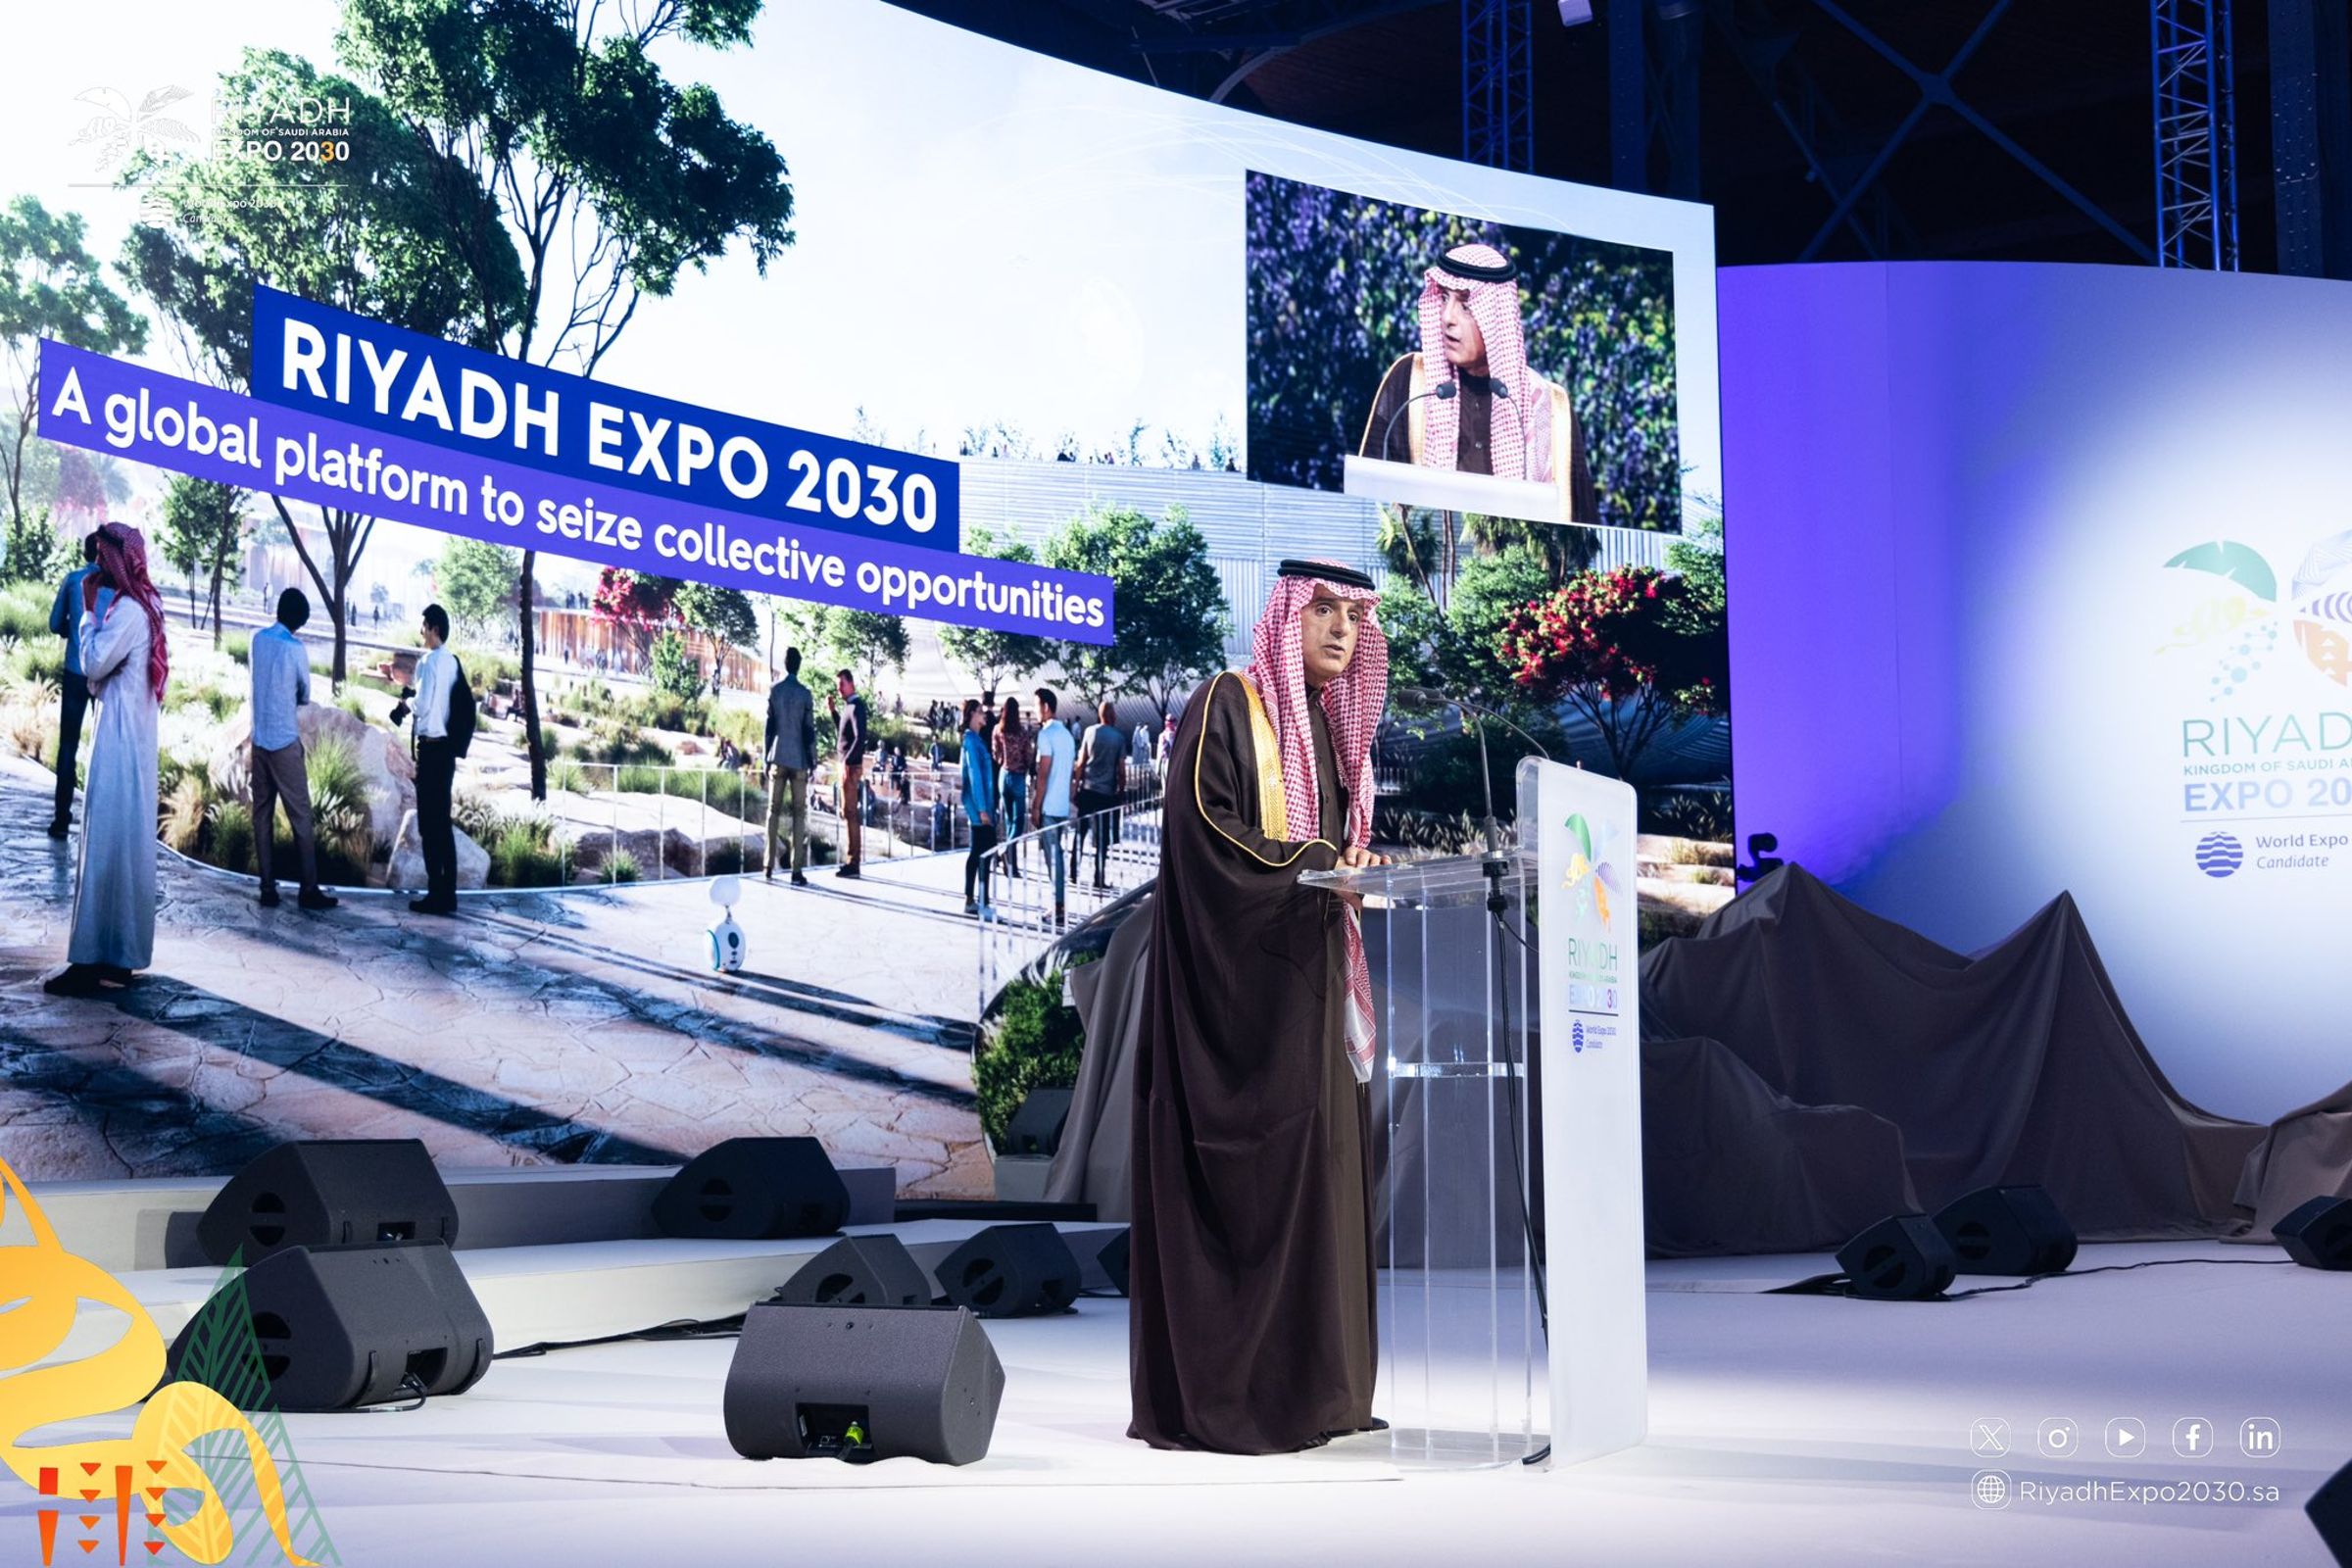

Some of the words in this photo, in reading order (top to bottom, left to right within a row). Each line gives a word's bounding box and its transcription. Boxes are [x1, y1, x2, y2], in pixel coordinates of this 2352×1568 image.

[281, 317, 561, 458] RIYADH
[588, 401, 769, 500] EXPO
[786, 449, 938, 534] 2030
[51, 366, 92, 425] A
[104, 388, 263, 469] global
[273, 432, 468, 516] platform
[480, 474, 525, 527] to
[536, 492, 643, 551] seize
[654, 521, 846, 588] collective
[855, 561, 1105, 628] opportunities
[2183, 762, 2256, 776] KINGDOM
[2260, 760, 2282, 772] OF
[2286, 758, 2334, 771] SAUDI
[2183, 778, 2293, 812] EXPO
[2255, 834, 2304, 850] World
[2309, 834, 2349, 850] Expo
[2256, 855, 2329, 870] Candidate
[1568, 937, 1618, 972] RIYDH
[1569, 983, 1594, 1007] EO
